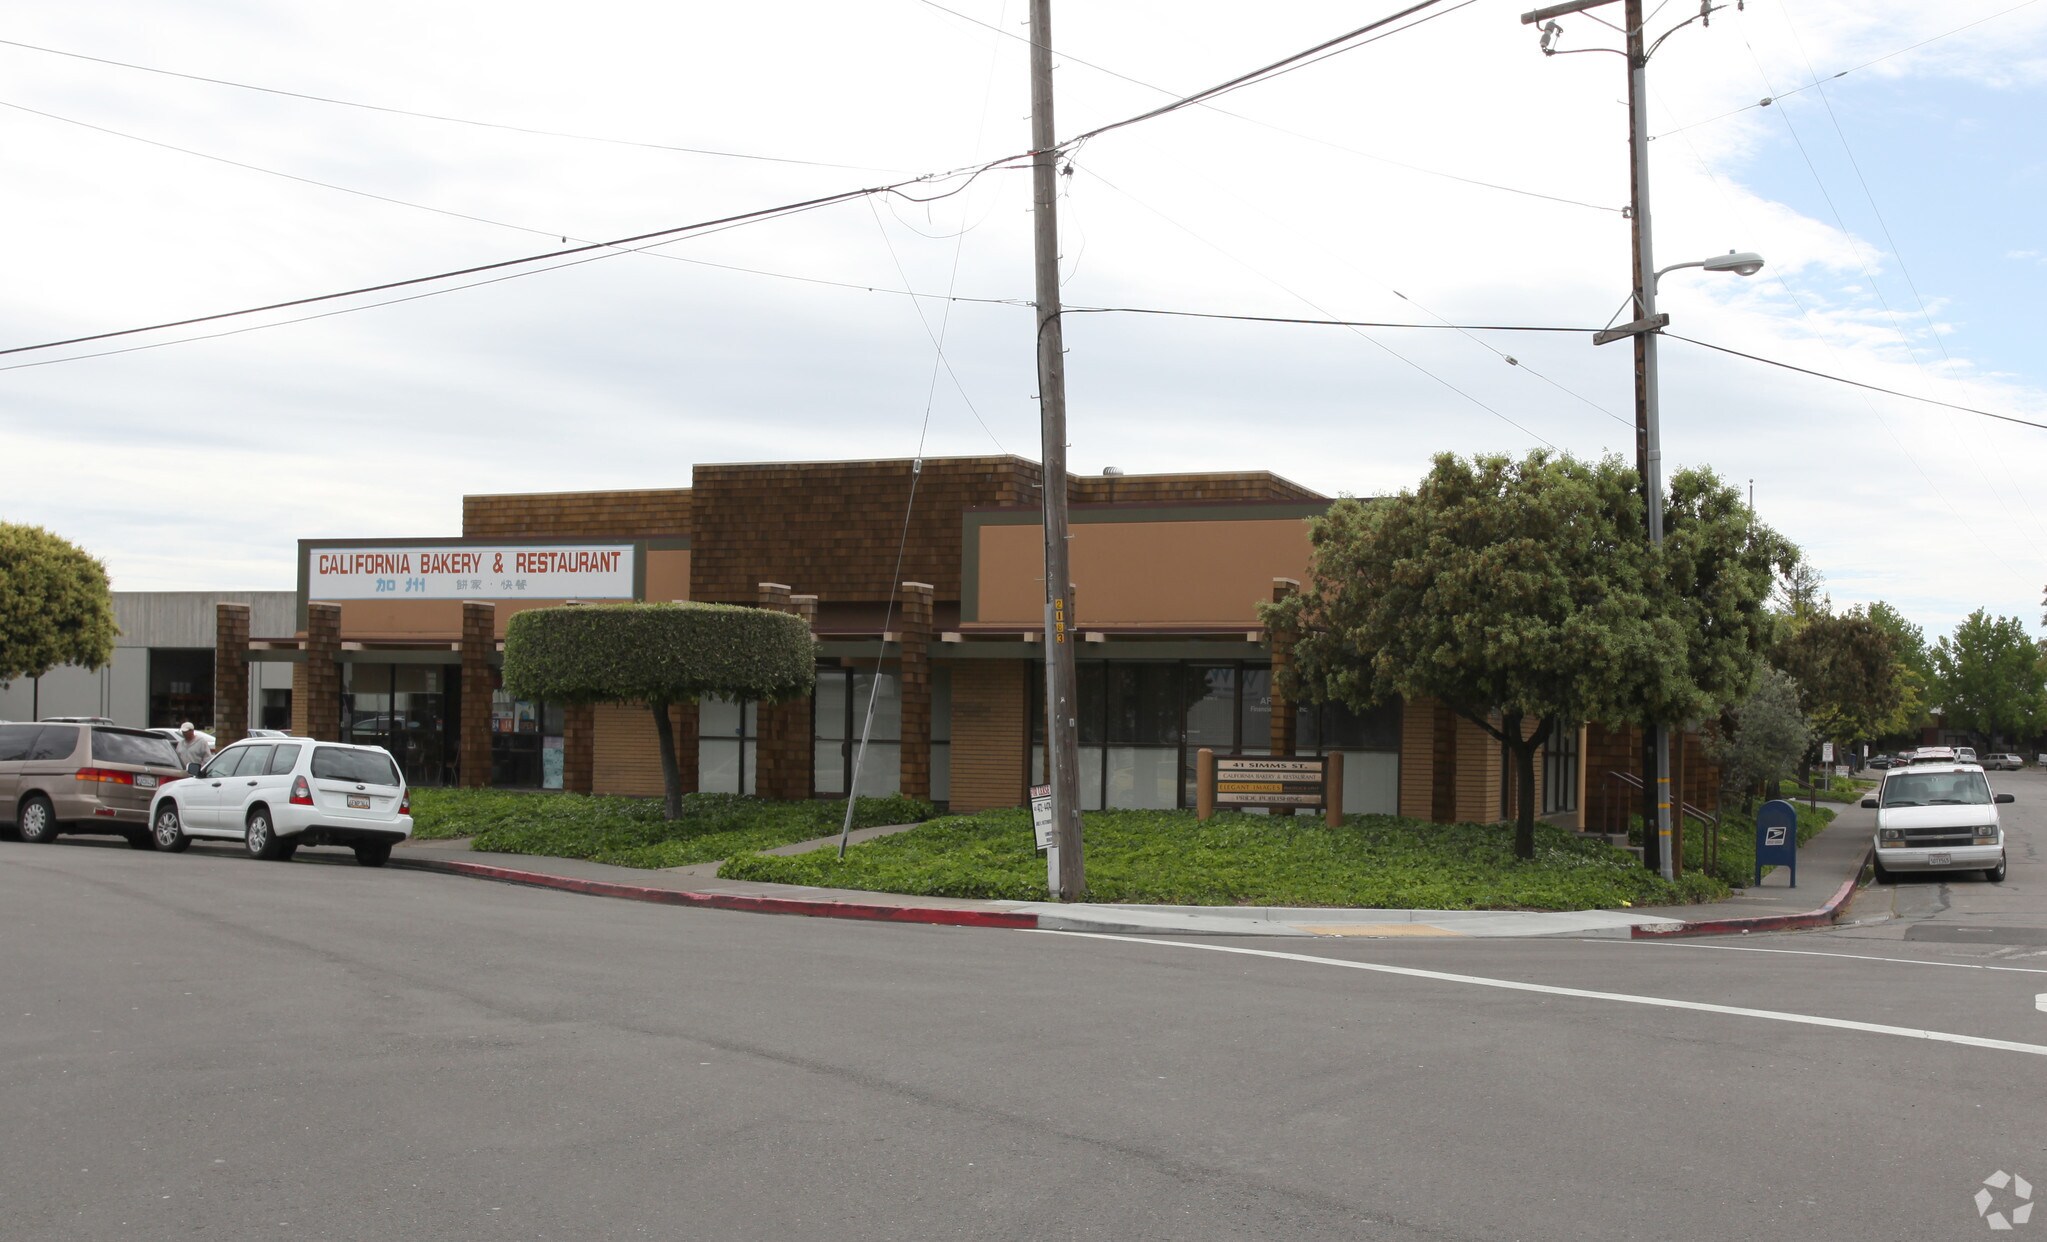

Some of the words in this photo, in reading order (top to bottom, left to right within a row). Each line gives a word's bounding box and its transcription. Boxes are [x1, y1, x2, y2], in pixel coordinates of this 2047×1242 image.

[319, 554, 411, 575] CALIFORNIA
[420, 553, 482, 574] BAKERY
[493, 552, 504, 573] &
[516, 551, 621, 574] RESTAURANT
[375, 577, 426, 592] 加州
